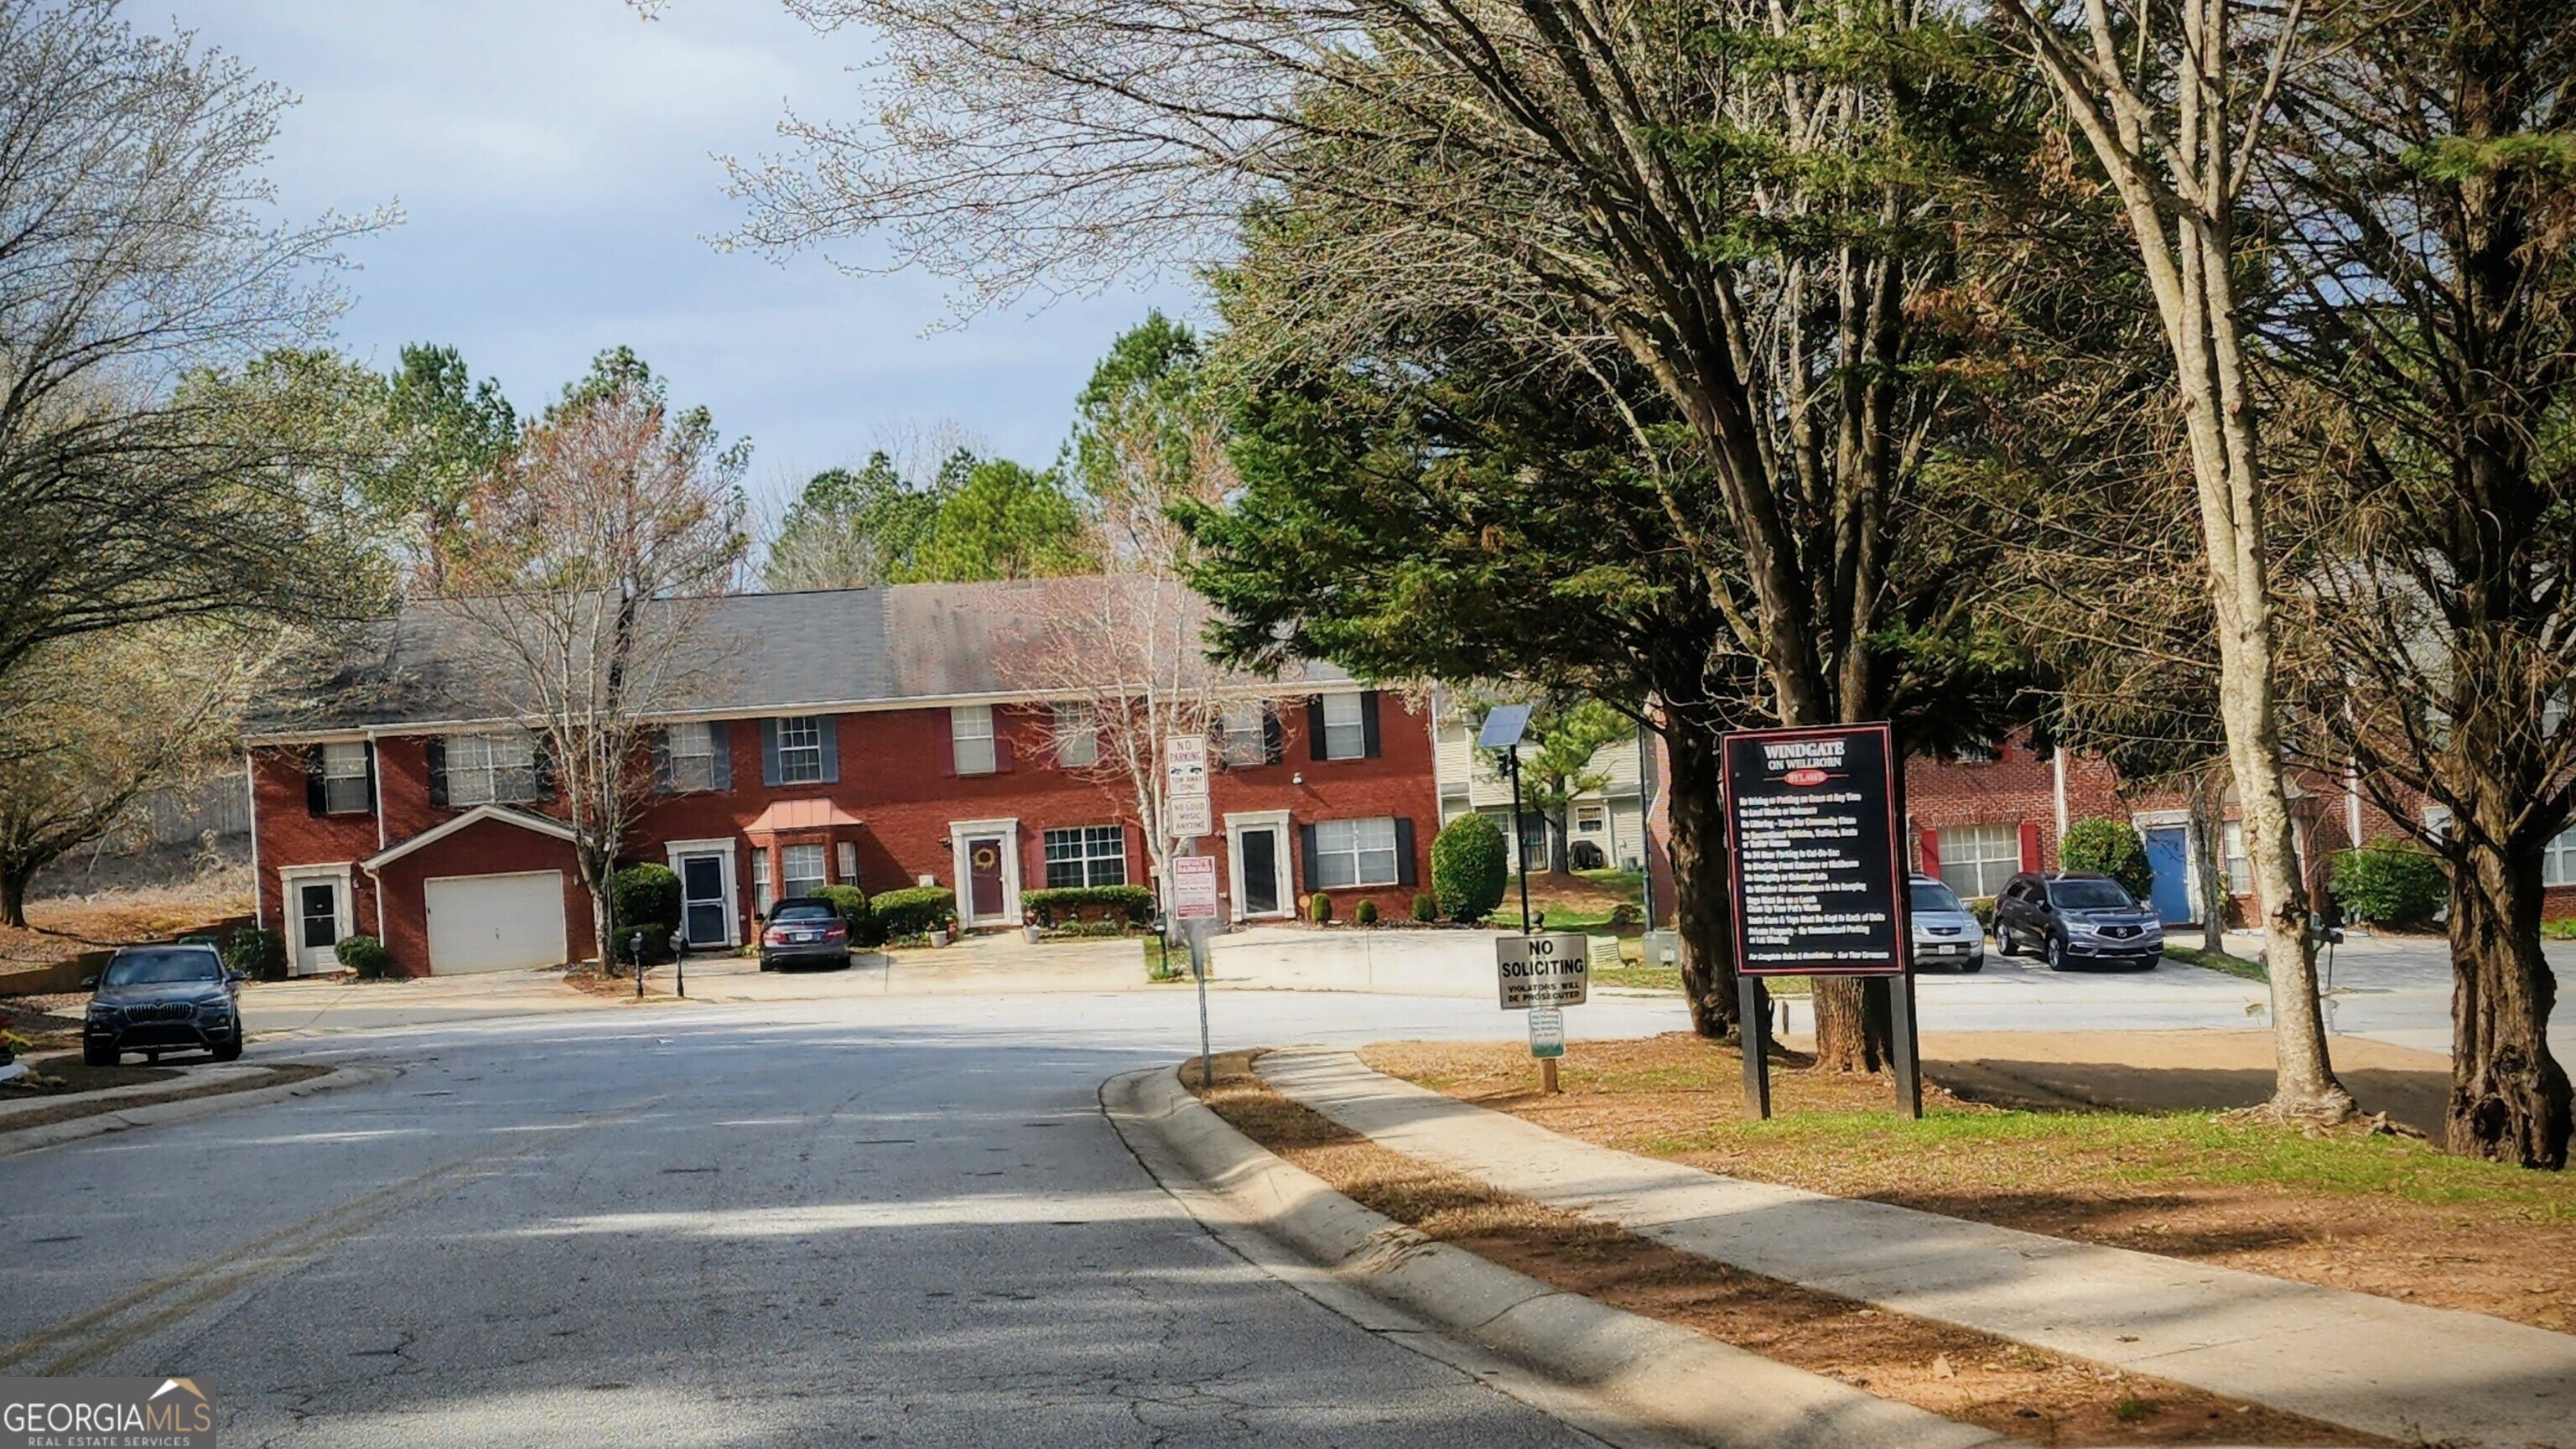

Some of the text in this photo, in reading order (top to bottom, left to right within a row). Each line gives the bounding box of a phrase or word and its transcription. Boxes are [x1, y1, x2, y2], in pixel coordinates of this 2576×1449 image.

[1177, 740, 1191, 750] NO
[1764, 741, 1845, 759] WINDGATE
[1169, 751, 1202, 761] PARKING
[1768, 756, 1841, 771] ON WELLBORN
[1529, 941, 1553, 956] NO
[1502, 958, 1583, 978] SOLICITING
[1508, 983, 1556, 993] VIOLATORS
[1523, 991, 1580, 1001] PROSECUTED
